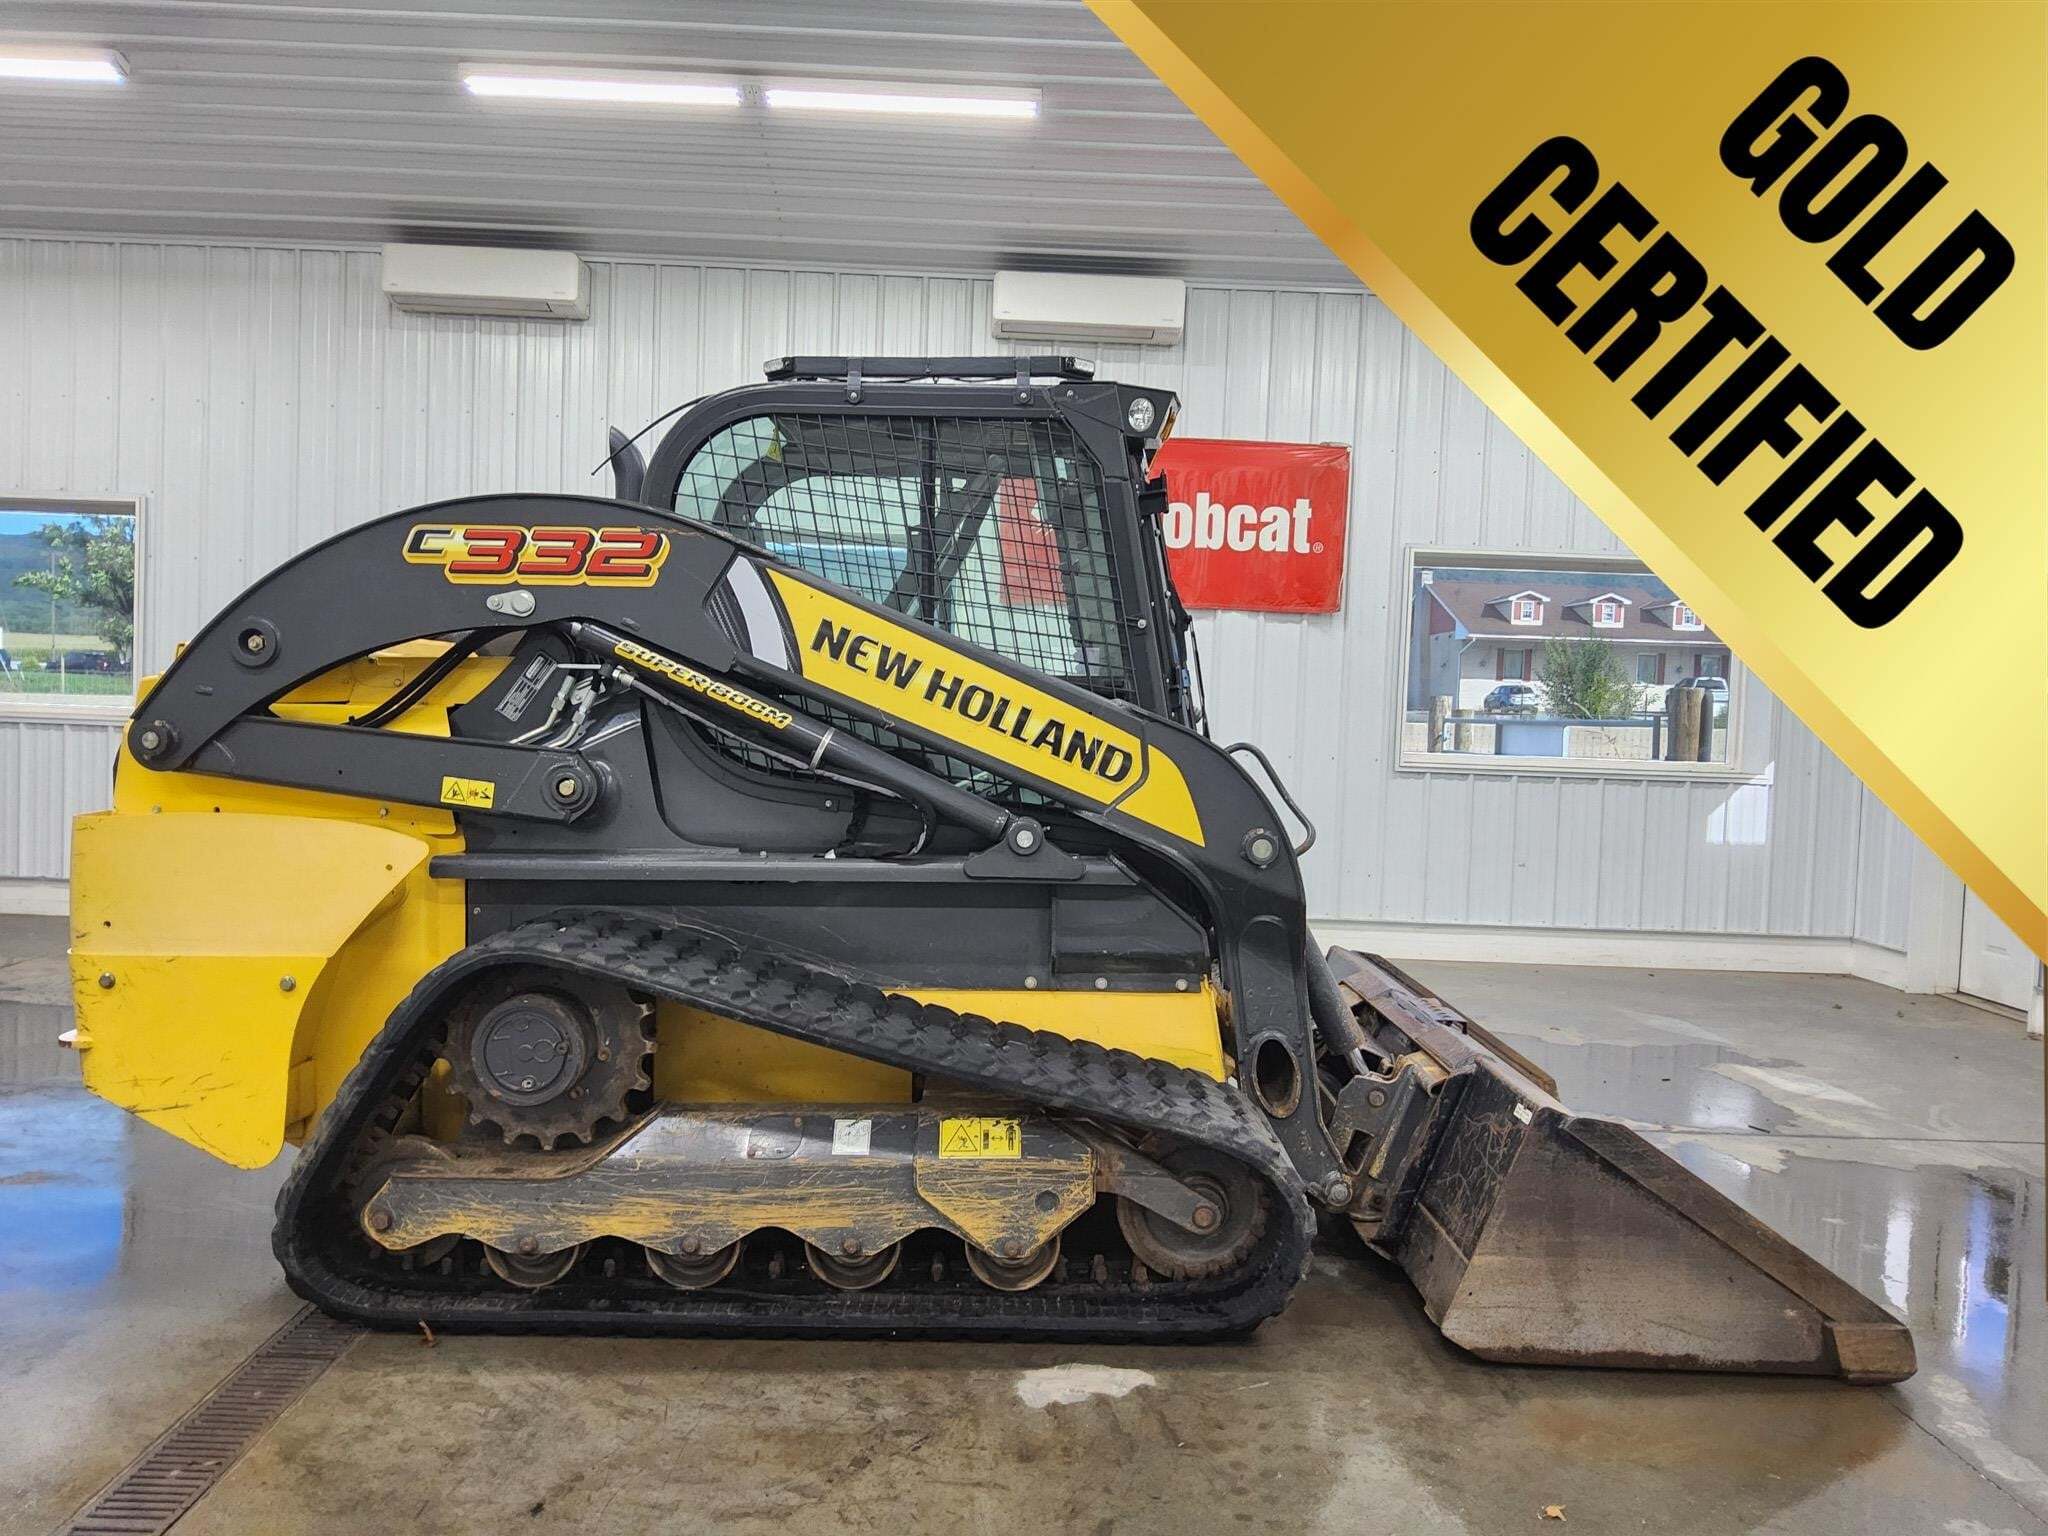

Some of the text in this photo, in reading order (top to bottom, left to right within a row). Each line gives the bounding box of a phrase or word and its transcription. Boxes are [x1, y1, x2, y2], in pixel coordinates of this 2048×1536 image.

[403, 527, 664, 578] C332
[1163, 491, 1313, 555] obcat
[810, 617, 1135, 784] NEW HOLLAND
